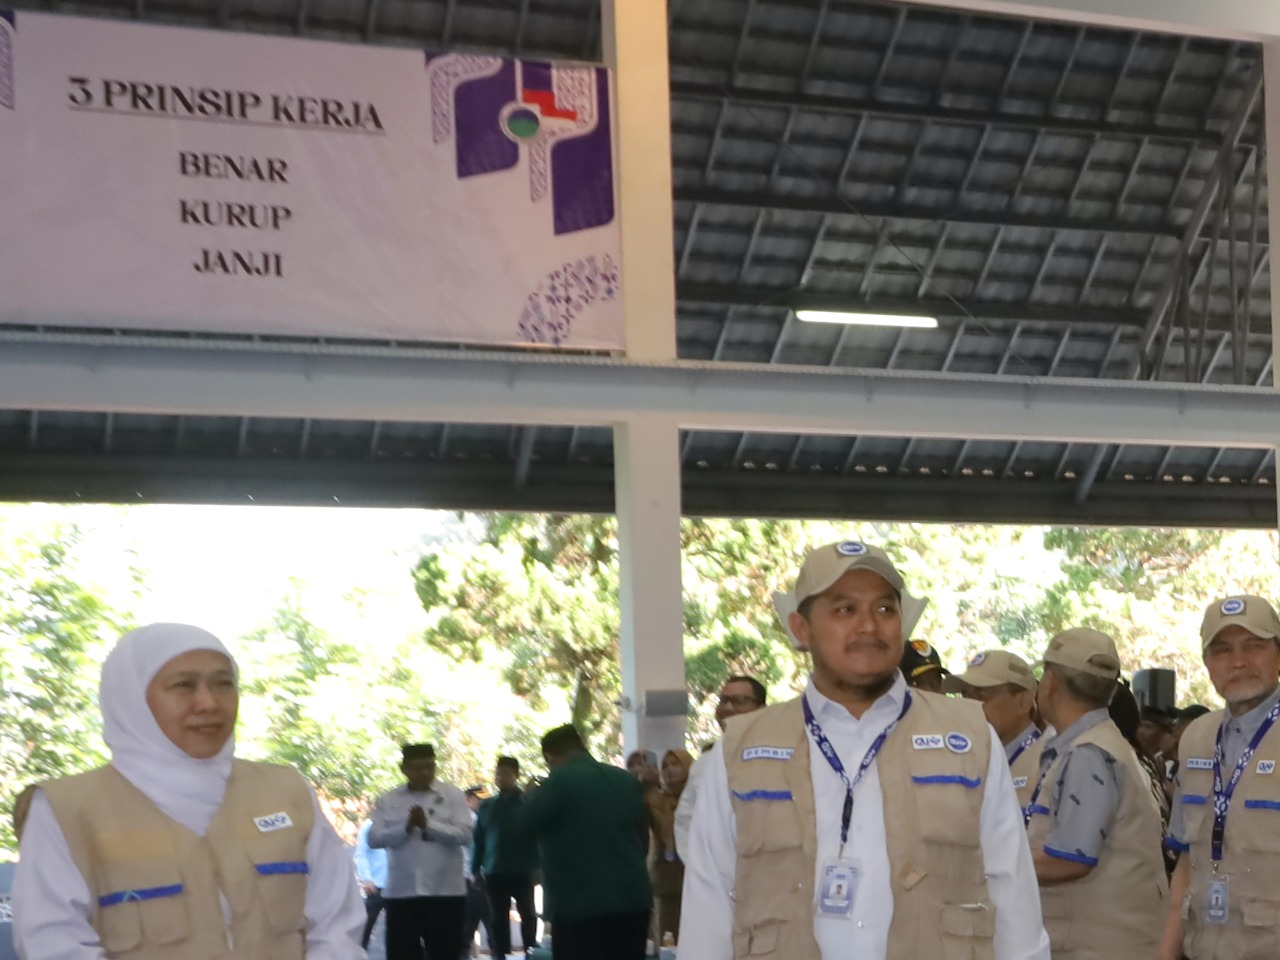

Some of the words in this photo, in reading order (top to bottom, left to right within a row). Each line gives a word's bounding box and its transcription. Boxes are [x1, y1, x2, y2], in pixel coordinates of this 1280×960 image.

[68, 76, 93, 105] 3
[101, 78, 262, 119] PRINSIP
[270, 92, 385, 131] KERJA
[179, 150, 289, 184] BENAR
[179, 198, 292, 230] KURUP
[193, 247, 284, 277] JANJI
